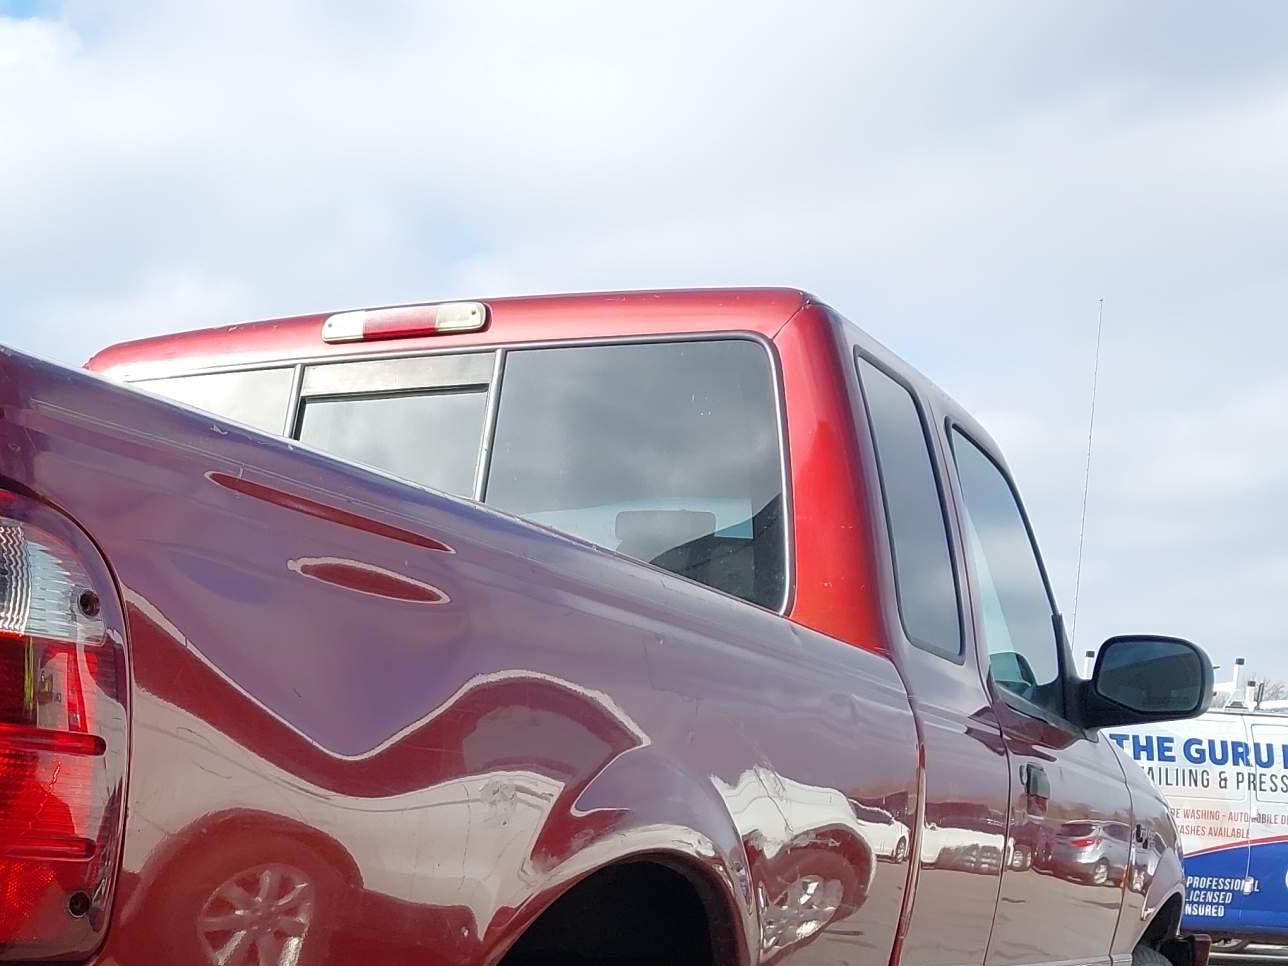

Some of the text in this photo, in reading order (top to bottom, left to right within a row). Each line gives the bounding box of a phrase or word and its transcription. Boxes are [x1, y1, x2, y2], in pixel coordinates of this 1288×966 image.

[1108, 733, 1176, 763] THE
[1183, 738, 1275, 769] GURU
[1218, 771, 1228, 789] &
[1183, 809, 1220, 820] WASHING
[1177, 825, 1250, 839] ASHES AVAILABLE
[1186, 876, 1259, 891] PROFESSIOL
[1185, 904, 1225, 917] NSURED
